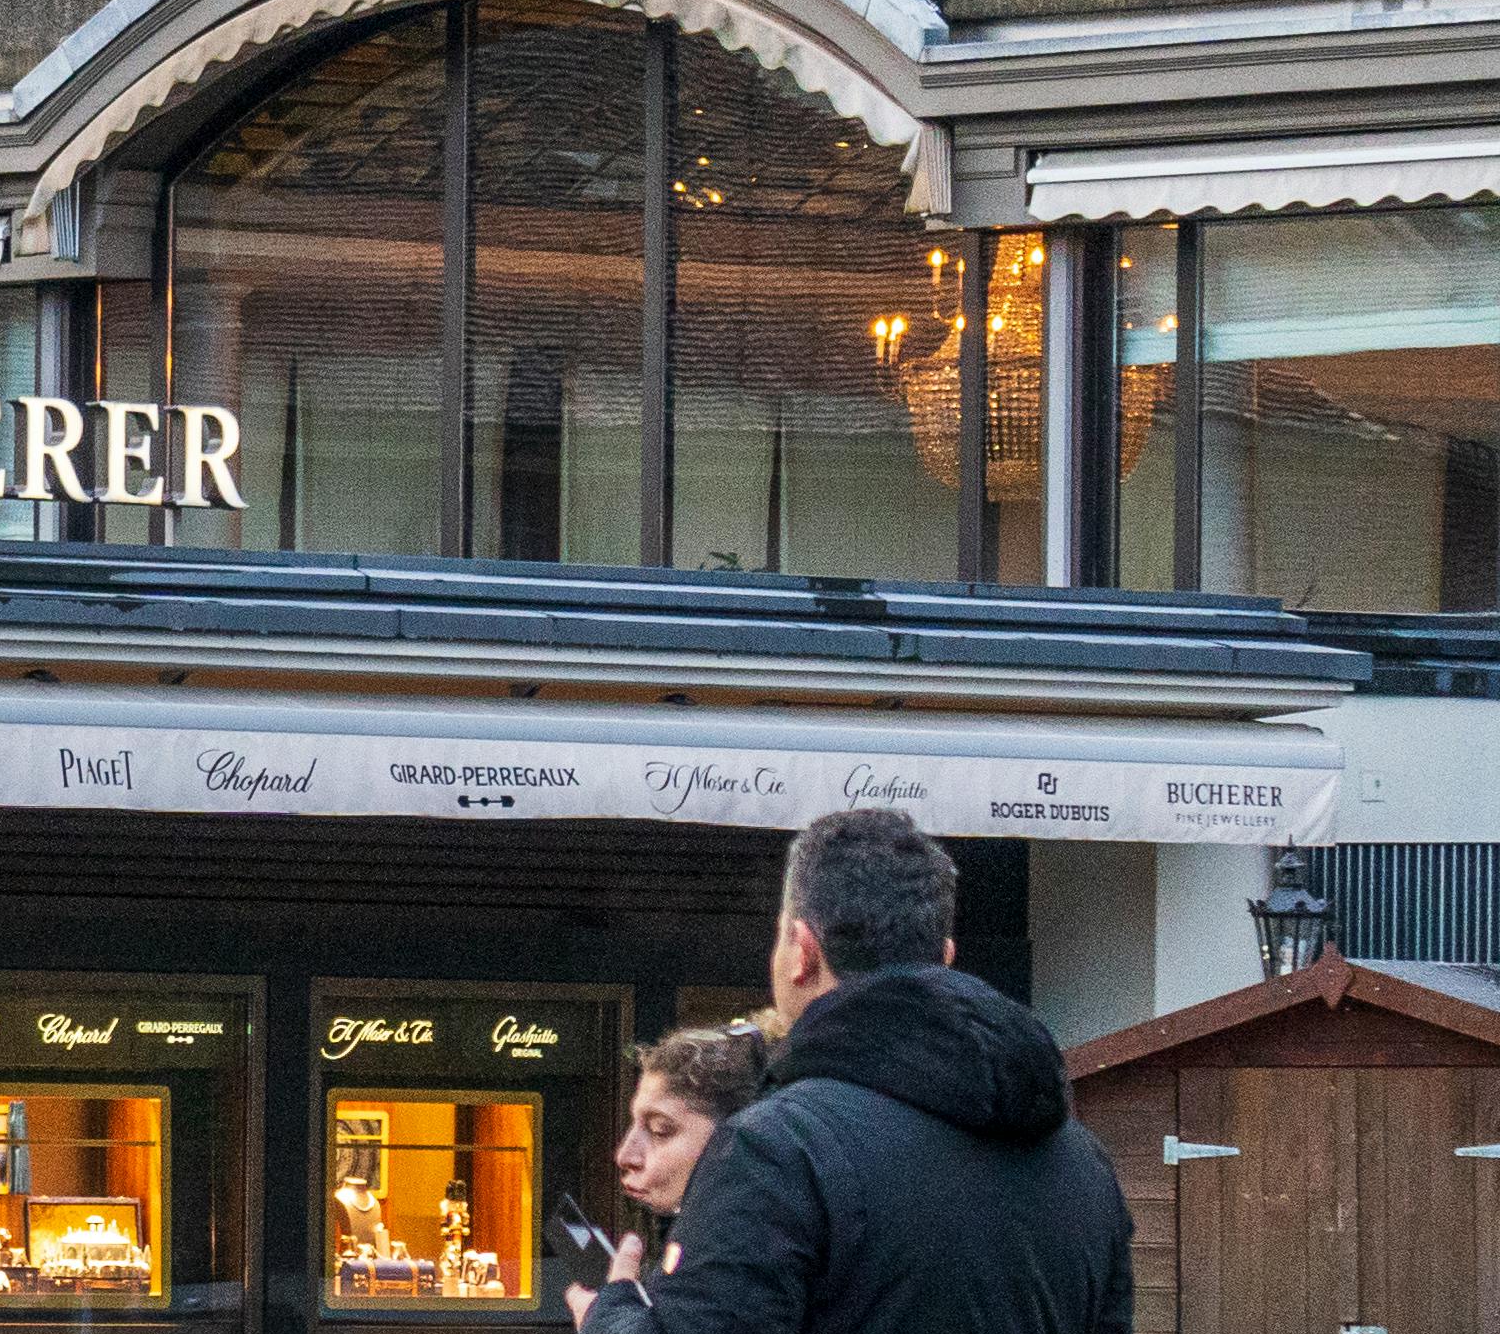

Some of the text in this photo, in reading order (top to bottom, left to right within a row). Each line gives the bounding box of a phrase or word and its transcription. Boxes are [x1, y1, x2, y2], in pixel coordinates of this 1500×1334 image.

[59, 747, 134, 791] PIAGET
[196, 748, 318, 801] Chopard
[389, 762, 581, 788] GIRARD-PERREGAUX
[1165, 781, 1285, 808] BUCHERER
[989, 801, 1110, 823] ROGER DUBUIS
[1175, 812, 1278, 829] FINE JEWELLERY
[37, 1013, 120, 1051] Chopard
[137, 1021, 224, 1035] GIRARD-PERREGAUX
[395, 1021, 410, 1044] &
